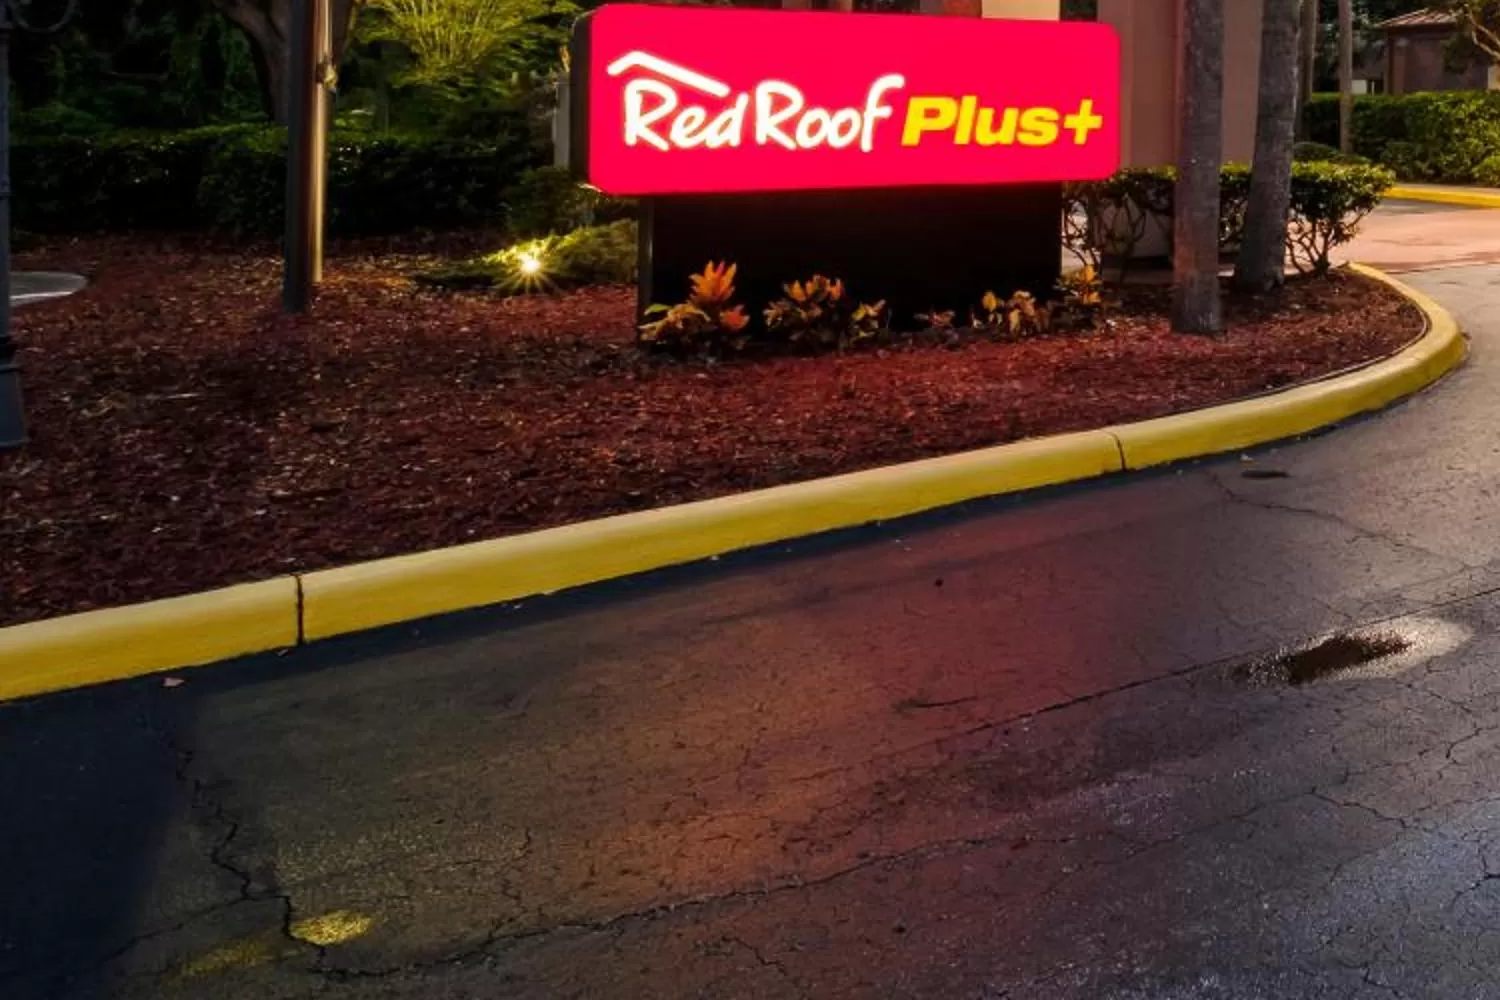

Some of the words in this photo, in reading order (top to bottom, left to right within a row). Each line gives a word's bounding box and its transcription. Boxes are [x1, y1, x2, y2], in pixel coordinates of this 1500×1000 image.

[622, 77, 752, 152] Red
[754, 73, 905, 153] Roof
[901, 95, 1104, 146] Plus+
